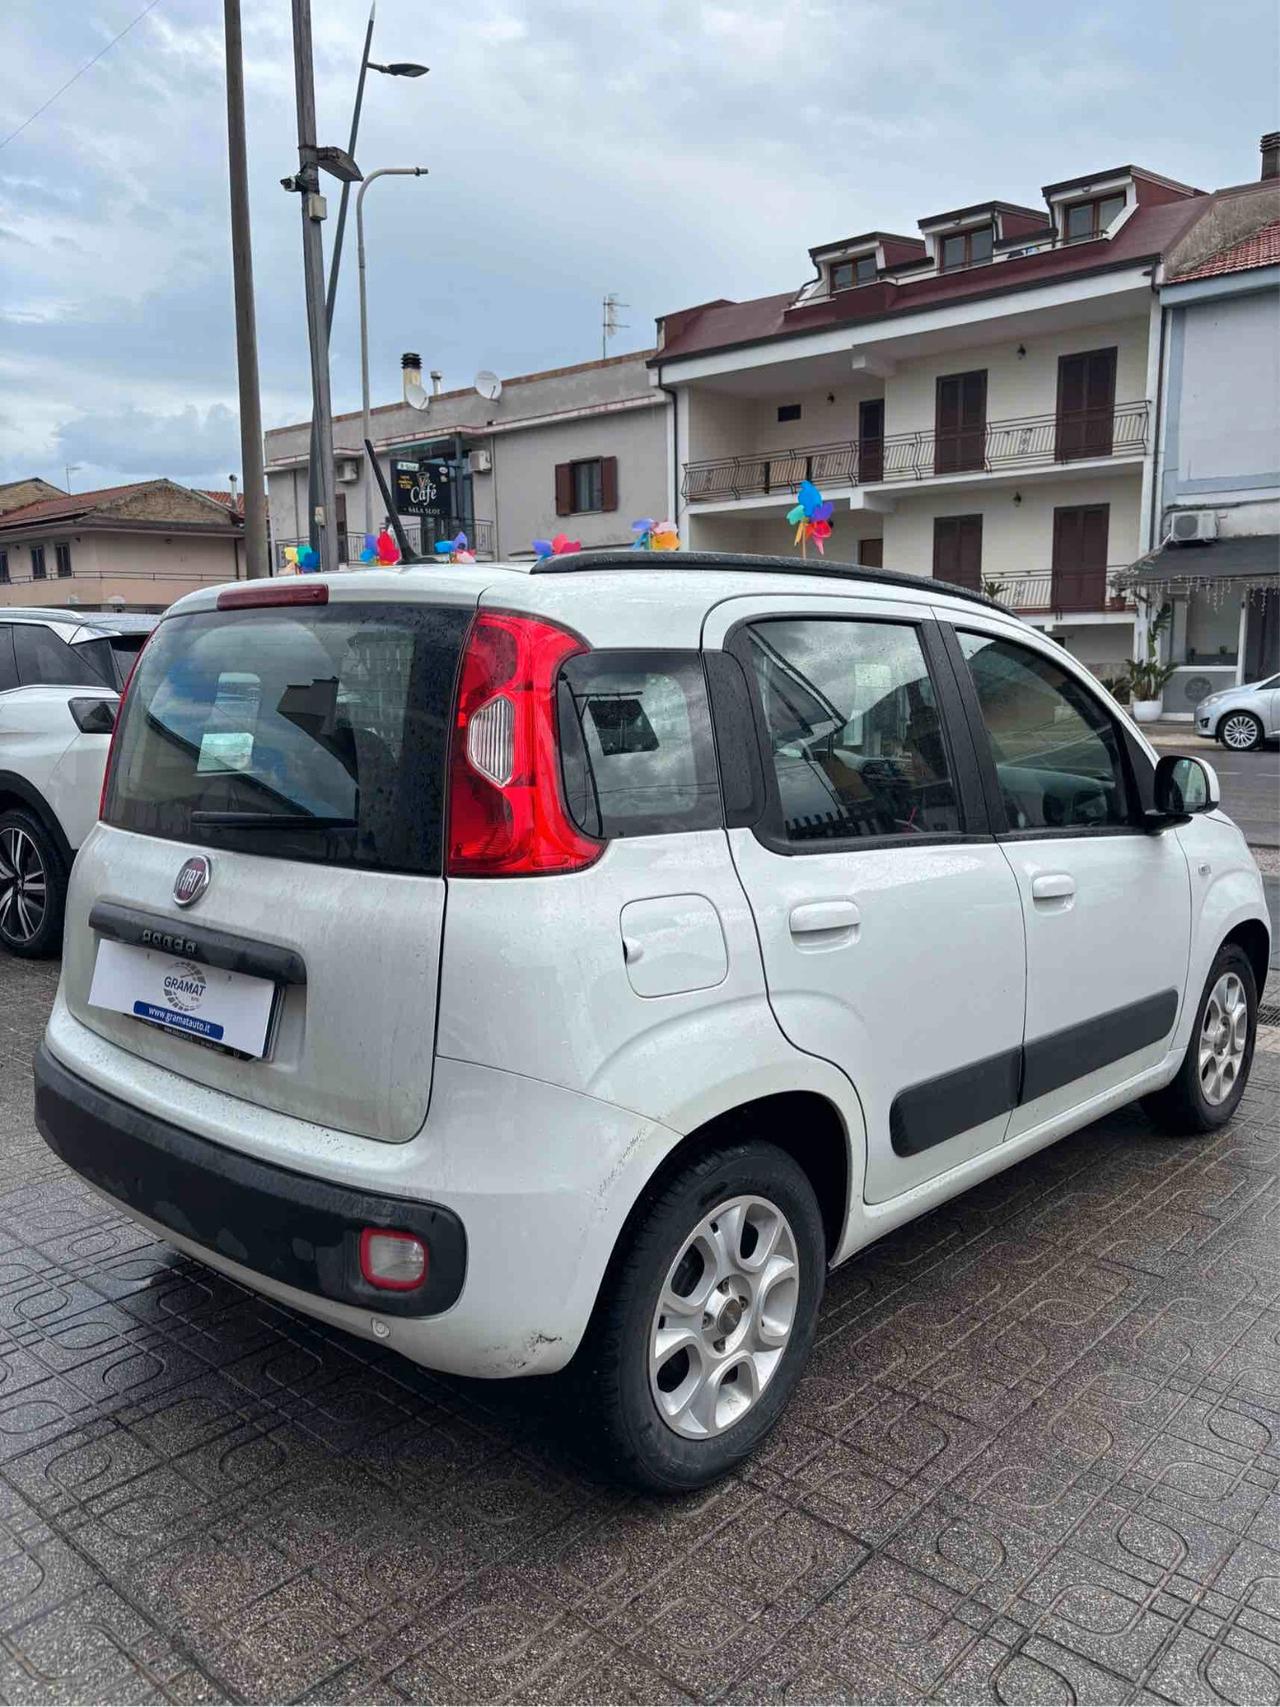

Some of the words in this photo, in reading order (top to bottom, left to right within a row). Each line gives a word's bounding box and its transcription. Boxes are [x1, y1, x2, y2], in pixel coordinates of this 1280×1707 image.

[410, 482, 437, 506] Café
[177, 868, 203, 893] FIAT
[164, 976, 206, 997] GRAMAT
[148, 1006, 211, 1034] www.gramatauto.it
